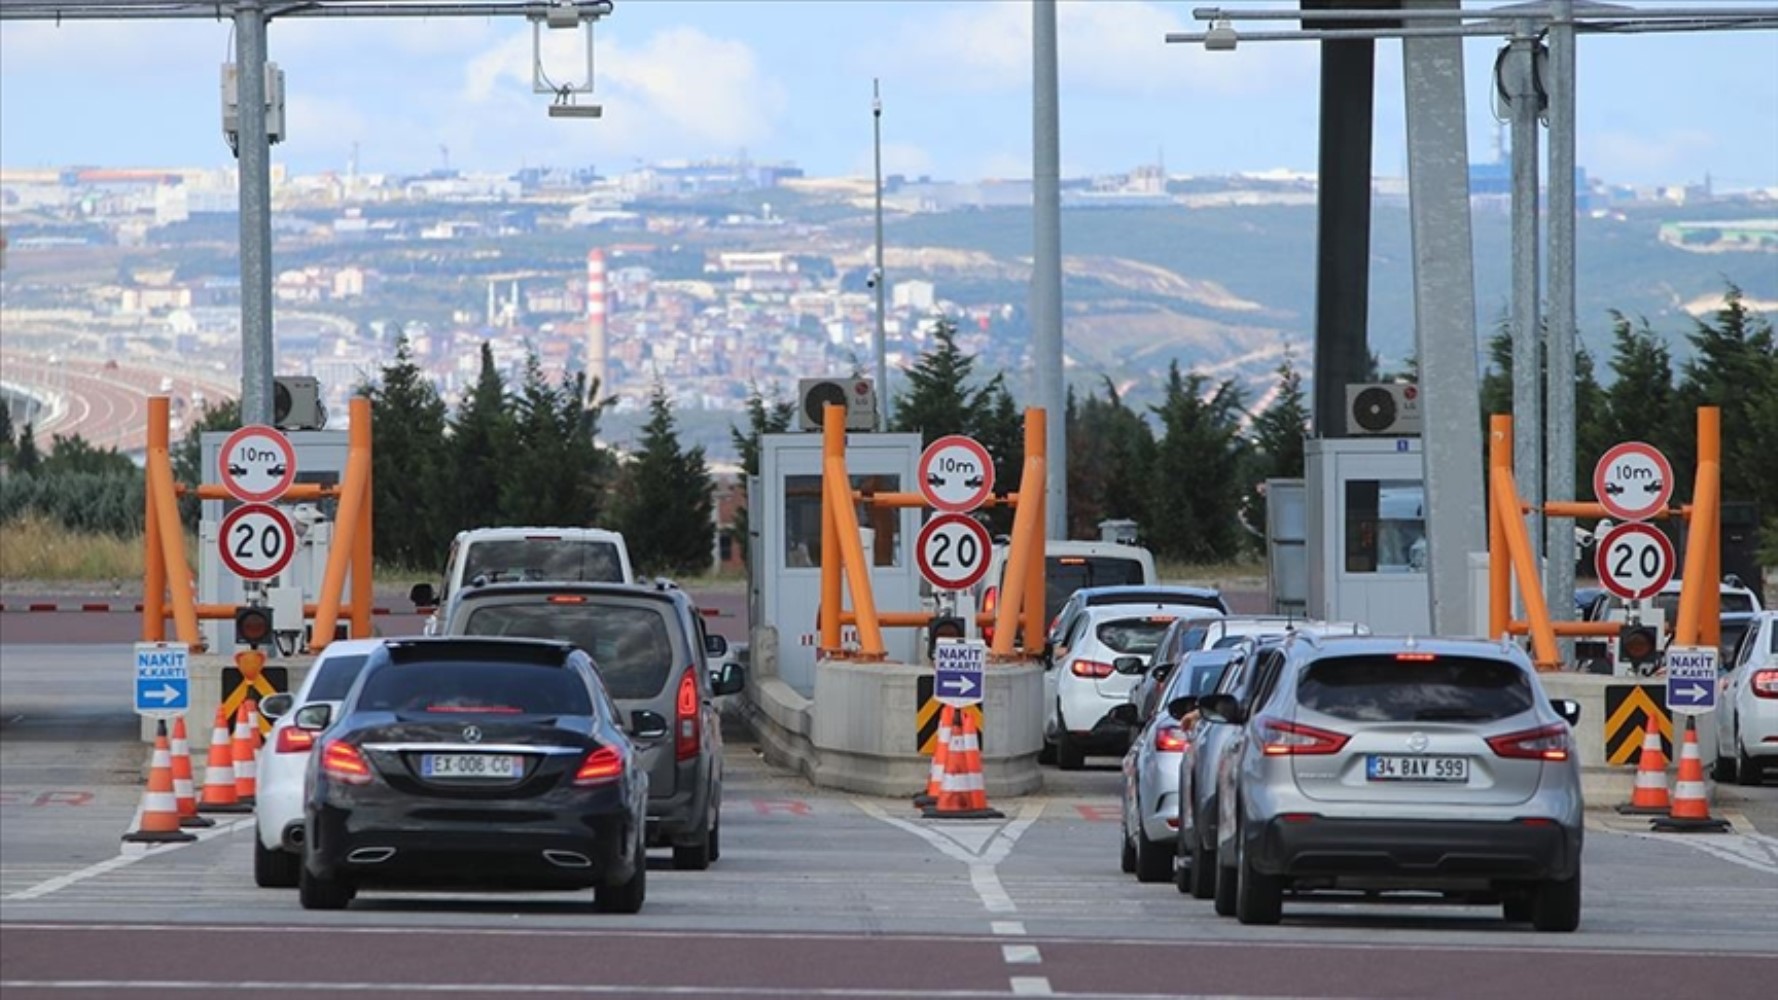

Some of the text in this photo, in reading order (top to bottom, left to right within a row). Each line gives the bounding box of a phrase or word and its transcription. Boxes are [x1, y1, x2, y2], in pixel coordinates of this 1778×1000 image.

[241, 447, 277, 461] 10m
[939, 457, 975, 473] 10m
[1616, 465, 1653, 480] 10m
[235, 524, 281, 558] 20
[932, 533, 977, 568] 20
[1614, 543, 1660, 578] 20
[138, 652, 185, 667] NAKİT
[939, 646, 981, 660] NAKİT
[1671, 654, 1714, 667] NAKİT
[1377, 758, 1464, 776] 34 BAV 599
